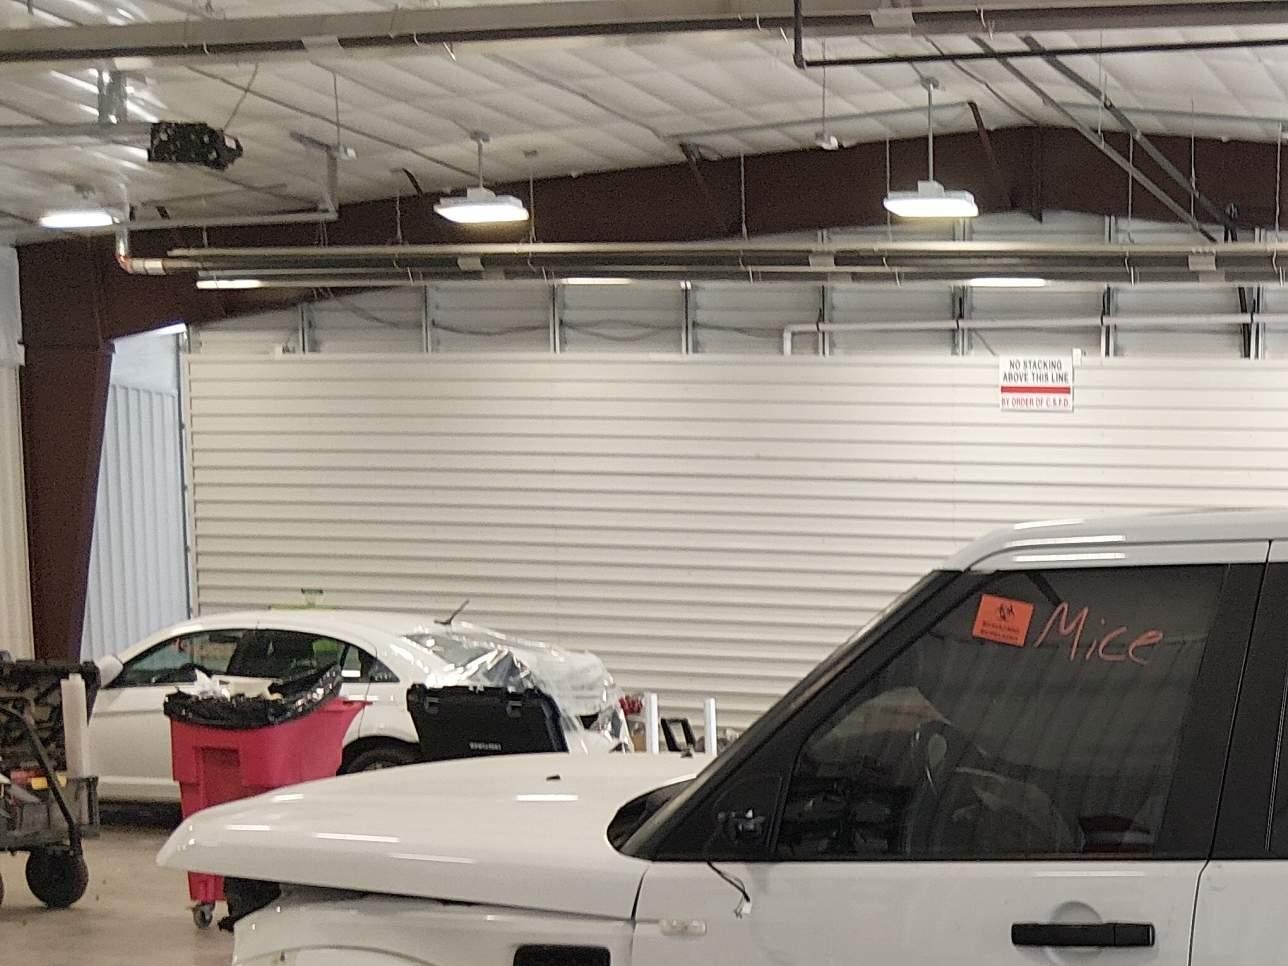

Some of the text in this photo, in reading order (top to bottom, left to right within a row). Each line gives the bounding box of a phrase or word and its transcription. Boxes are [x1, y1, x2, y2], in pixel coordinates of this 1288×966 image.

[1009, 359, 1063, 371] NO STACKING
[1003, 372, 1069, 384] ABOVE THIS LINE
[1034, 602, 1164, 665] Mice
